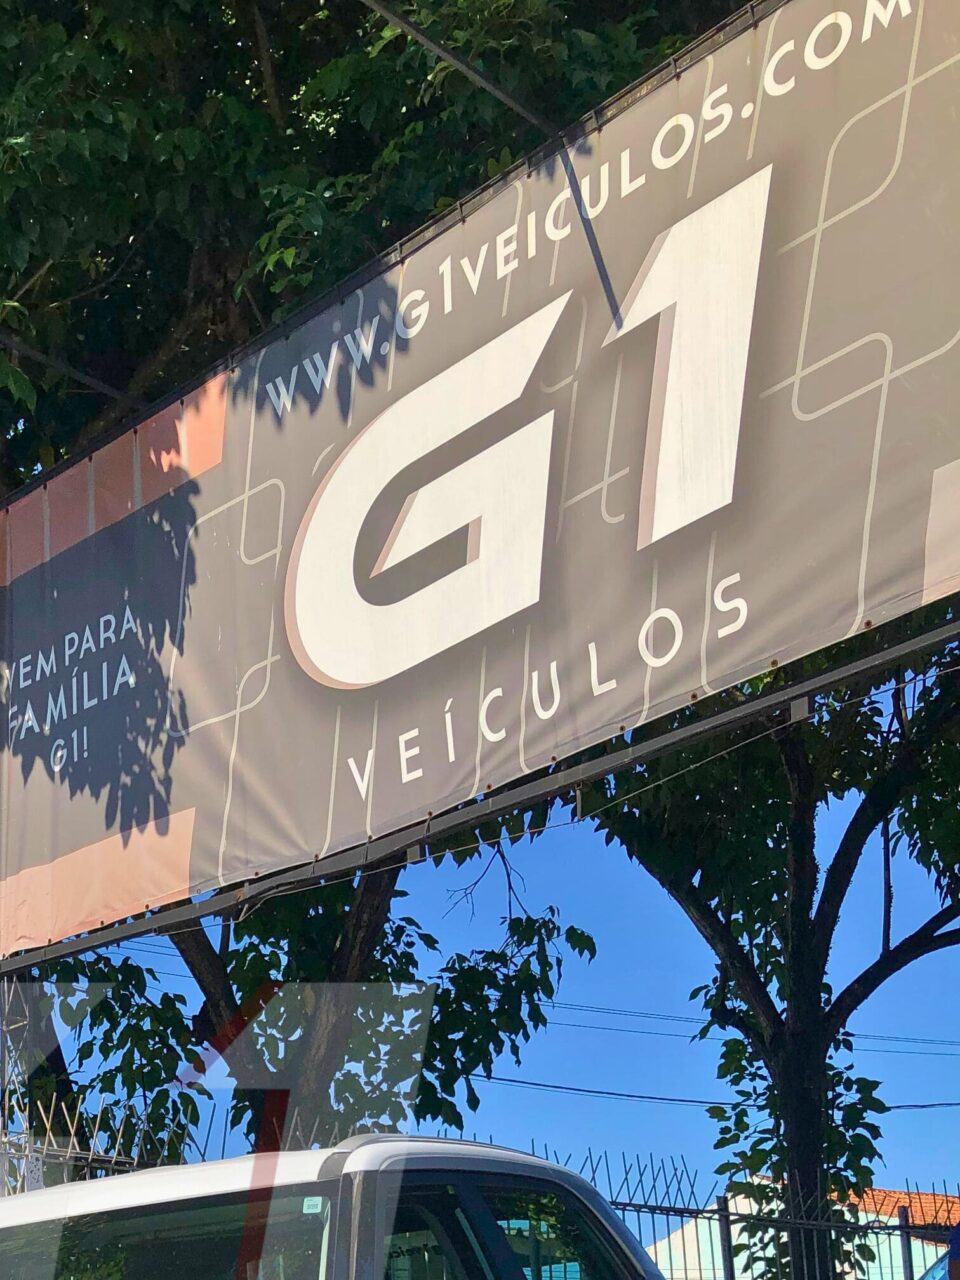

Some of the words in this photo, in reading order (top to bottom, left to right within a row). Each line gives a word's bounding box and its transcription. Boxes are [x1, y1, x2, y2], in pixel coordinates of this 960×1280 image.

[265, 0, 913, 420] WWW.G1VEICULOS.COM
[284, 163, 773, 690] G1
[9, 654, 136, 745] FAMÍLIA
[64, 605, 137, 666] PARA
[348, 571, 749, 801] VEÍCULOS
[50, 726, 89, 772] G1!
